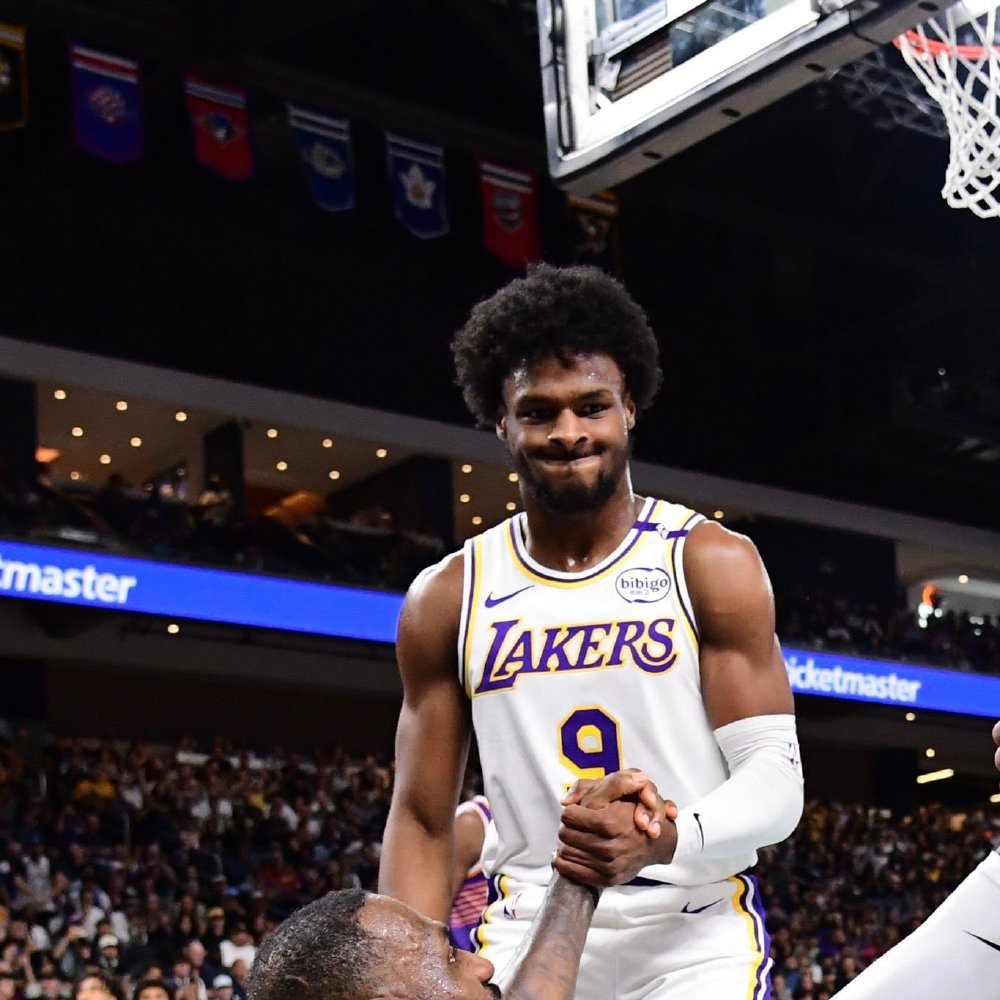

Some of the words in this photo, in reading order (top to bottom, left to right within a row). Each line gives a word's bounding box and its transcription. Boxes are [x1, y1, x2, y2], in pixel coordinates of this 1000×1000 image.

[0, 554, 137, 604] master
[621, 577, 668, 592] bibigo
[473, 617, 678, 696] LAKERS
[786, 657, 922, 702] icketmaster
[557, 704, 624, 793] 9
